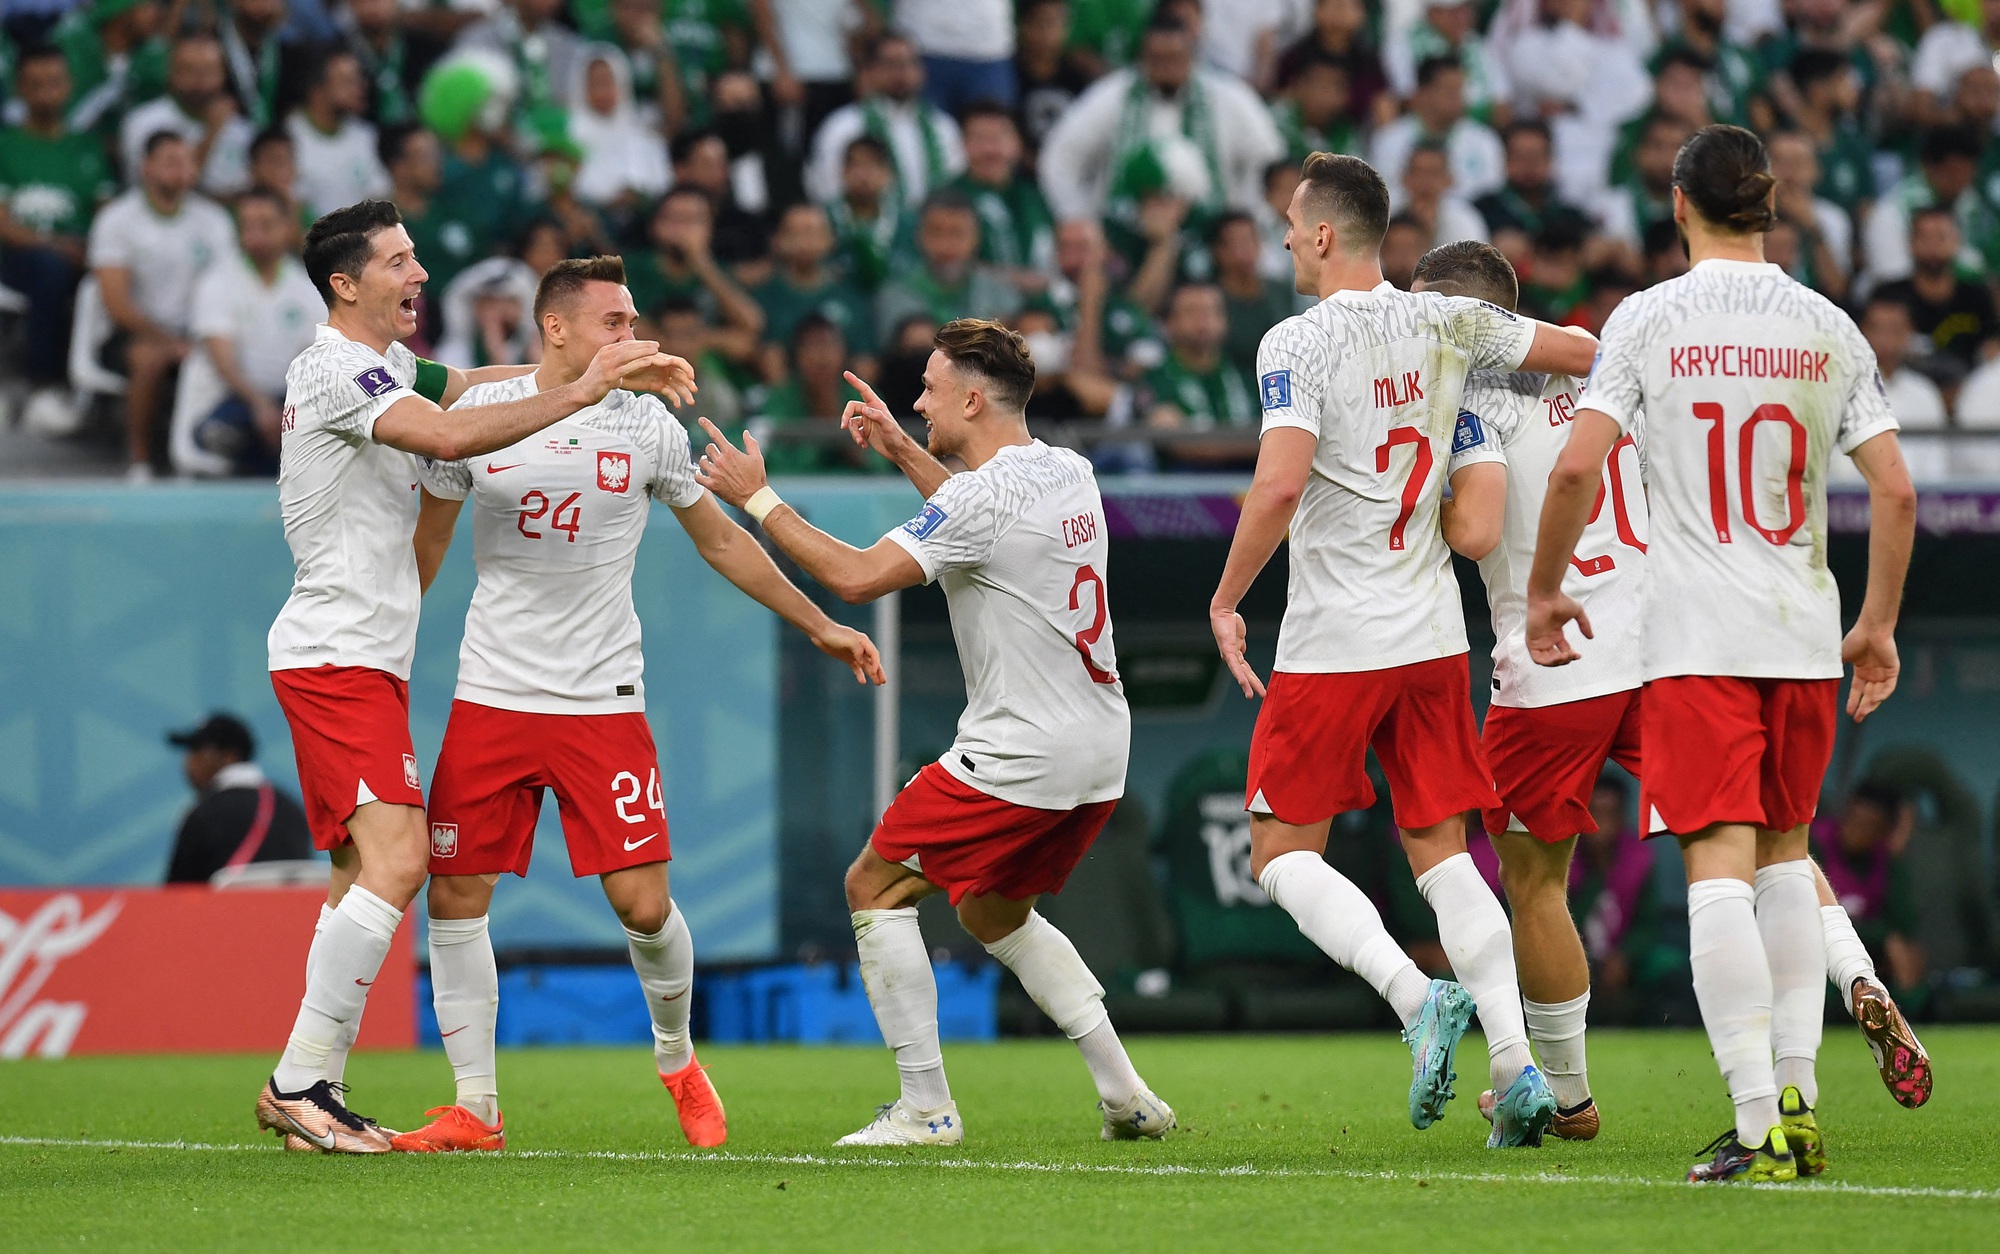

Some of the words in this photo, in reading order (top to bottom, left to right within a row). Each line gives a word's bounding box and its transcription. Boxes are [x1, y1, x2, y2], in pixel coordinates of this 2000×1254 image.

[1670, 345, 1829, 383] KRYCHOWIAK
[1375, 426, 1433, 551] 7
[1692, 402, 1807, 546] 10
[518, 489, 582, 543] 24
[1061, 511, 1097, 549] CASH
[1068, 564, 1117, 685] 2
[611, 767, 666, 824] 24
